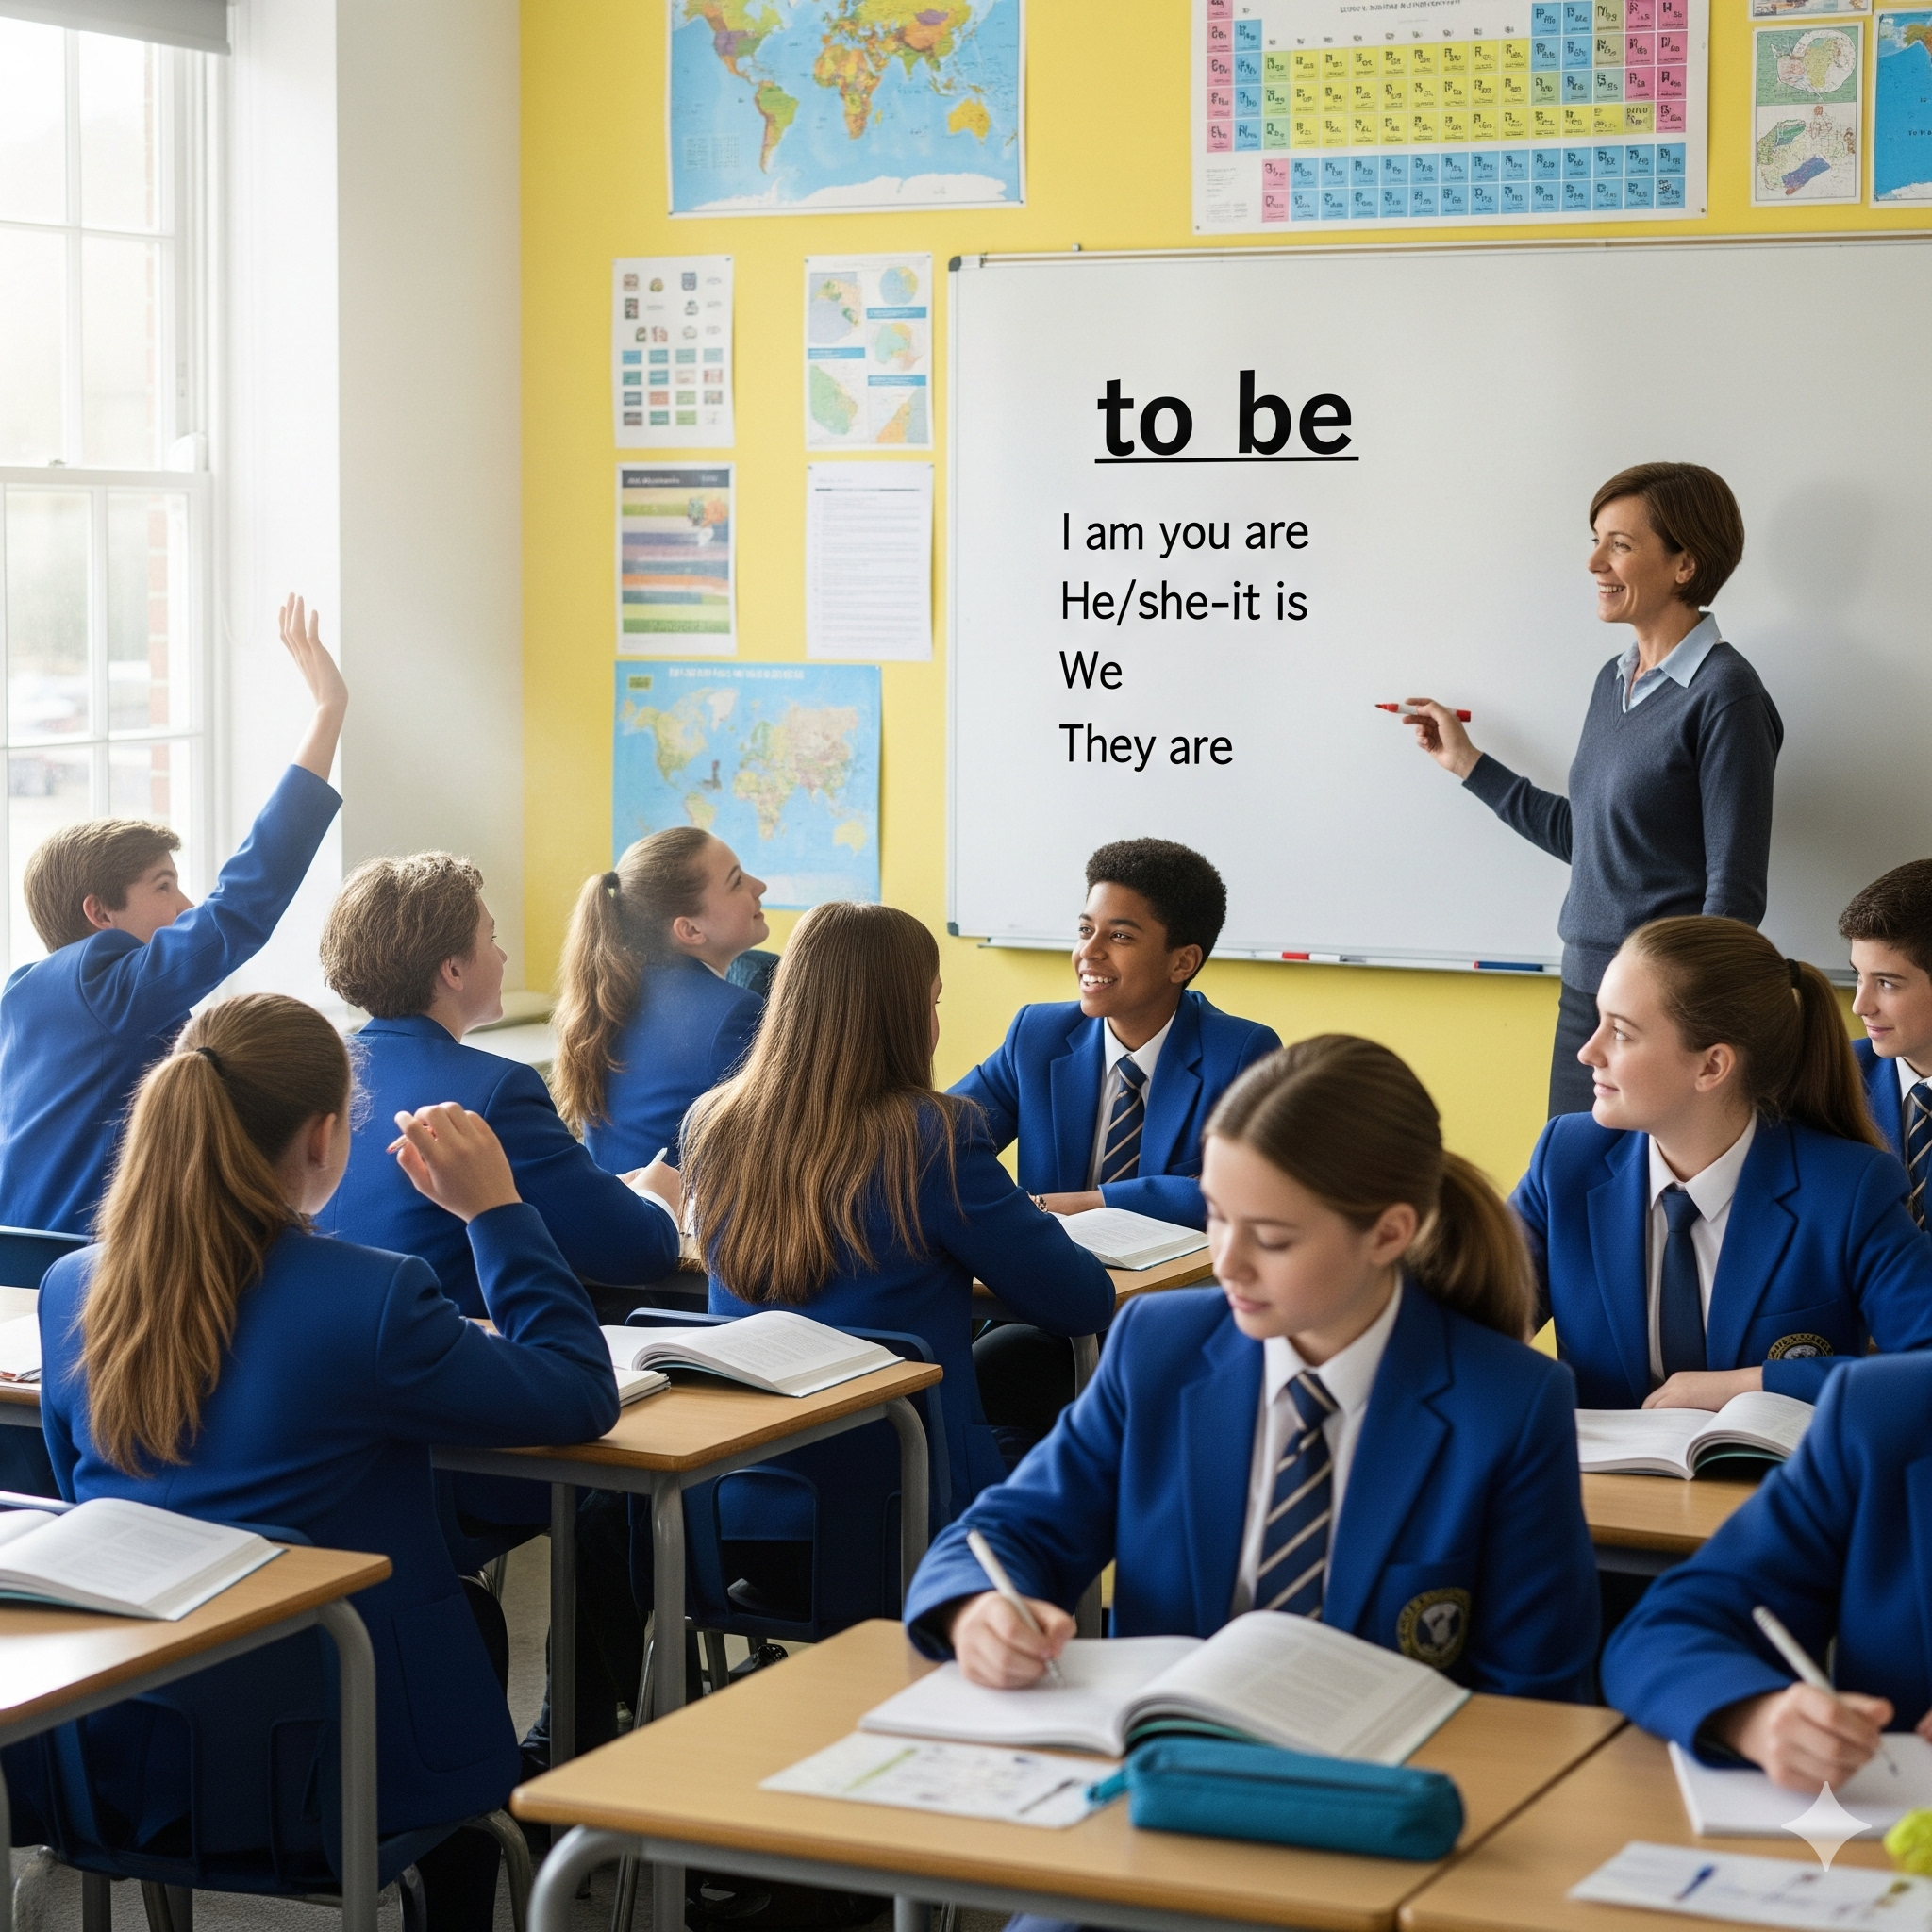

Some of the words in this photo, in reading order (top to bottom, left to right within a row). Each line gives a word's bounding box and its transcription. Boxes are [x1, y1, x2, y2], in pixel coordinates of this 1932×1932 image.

[1097, 378, 1193, 457] to
[1238, 369, 1352, 456] be
[1062, 512, 1070, 551] I
[1086, 522, 1143, 551] am
[1158, 522, 1230, 559] you
[1245, 521, 1309, 550] are
[1062, 578, 1261, 626] He/she-it
[1276, 580, 1308, 621] is
[1058, 650, 1123, 690] We
[1058, 722, 1157, 773] They
[1169, 736, 1233, 765] are
